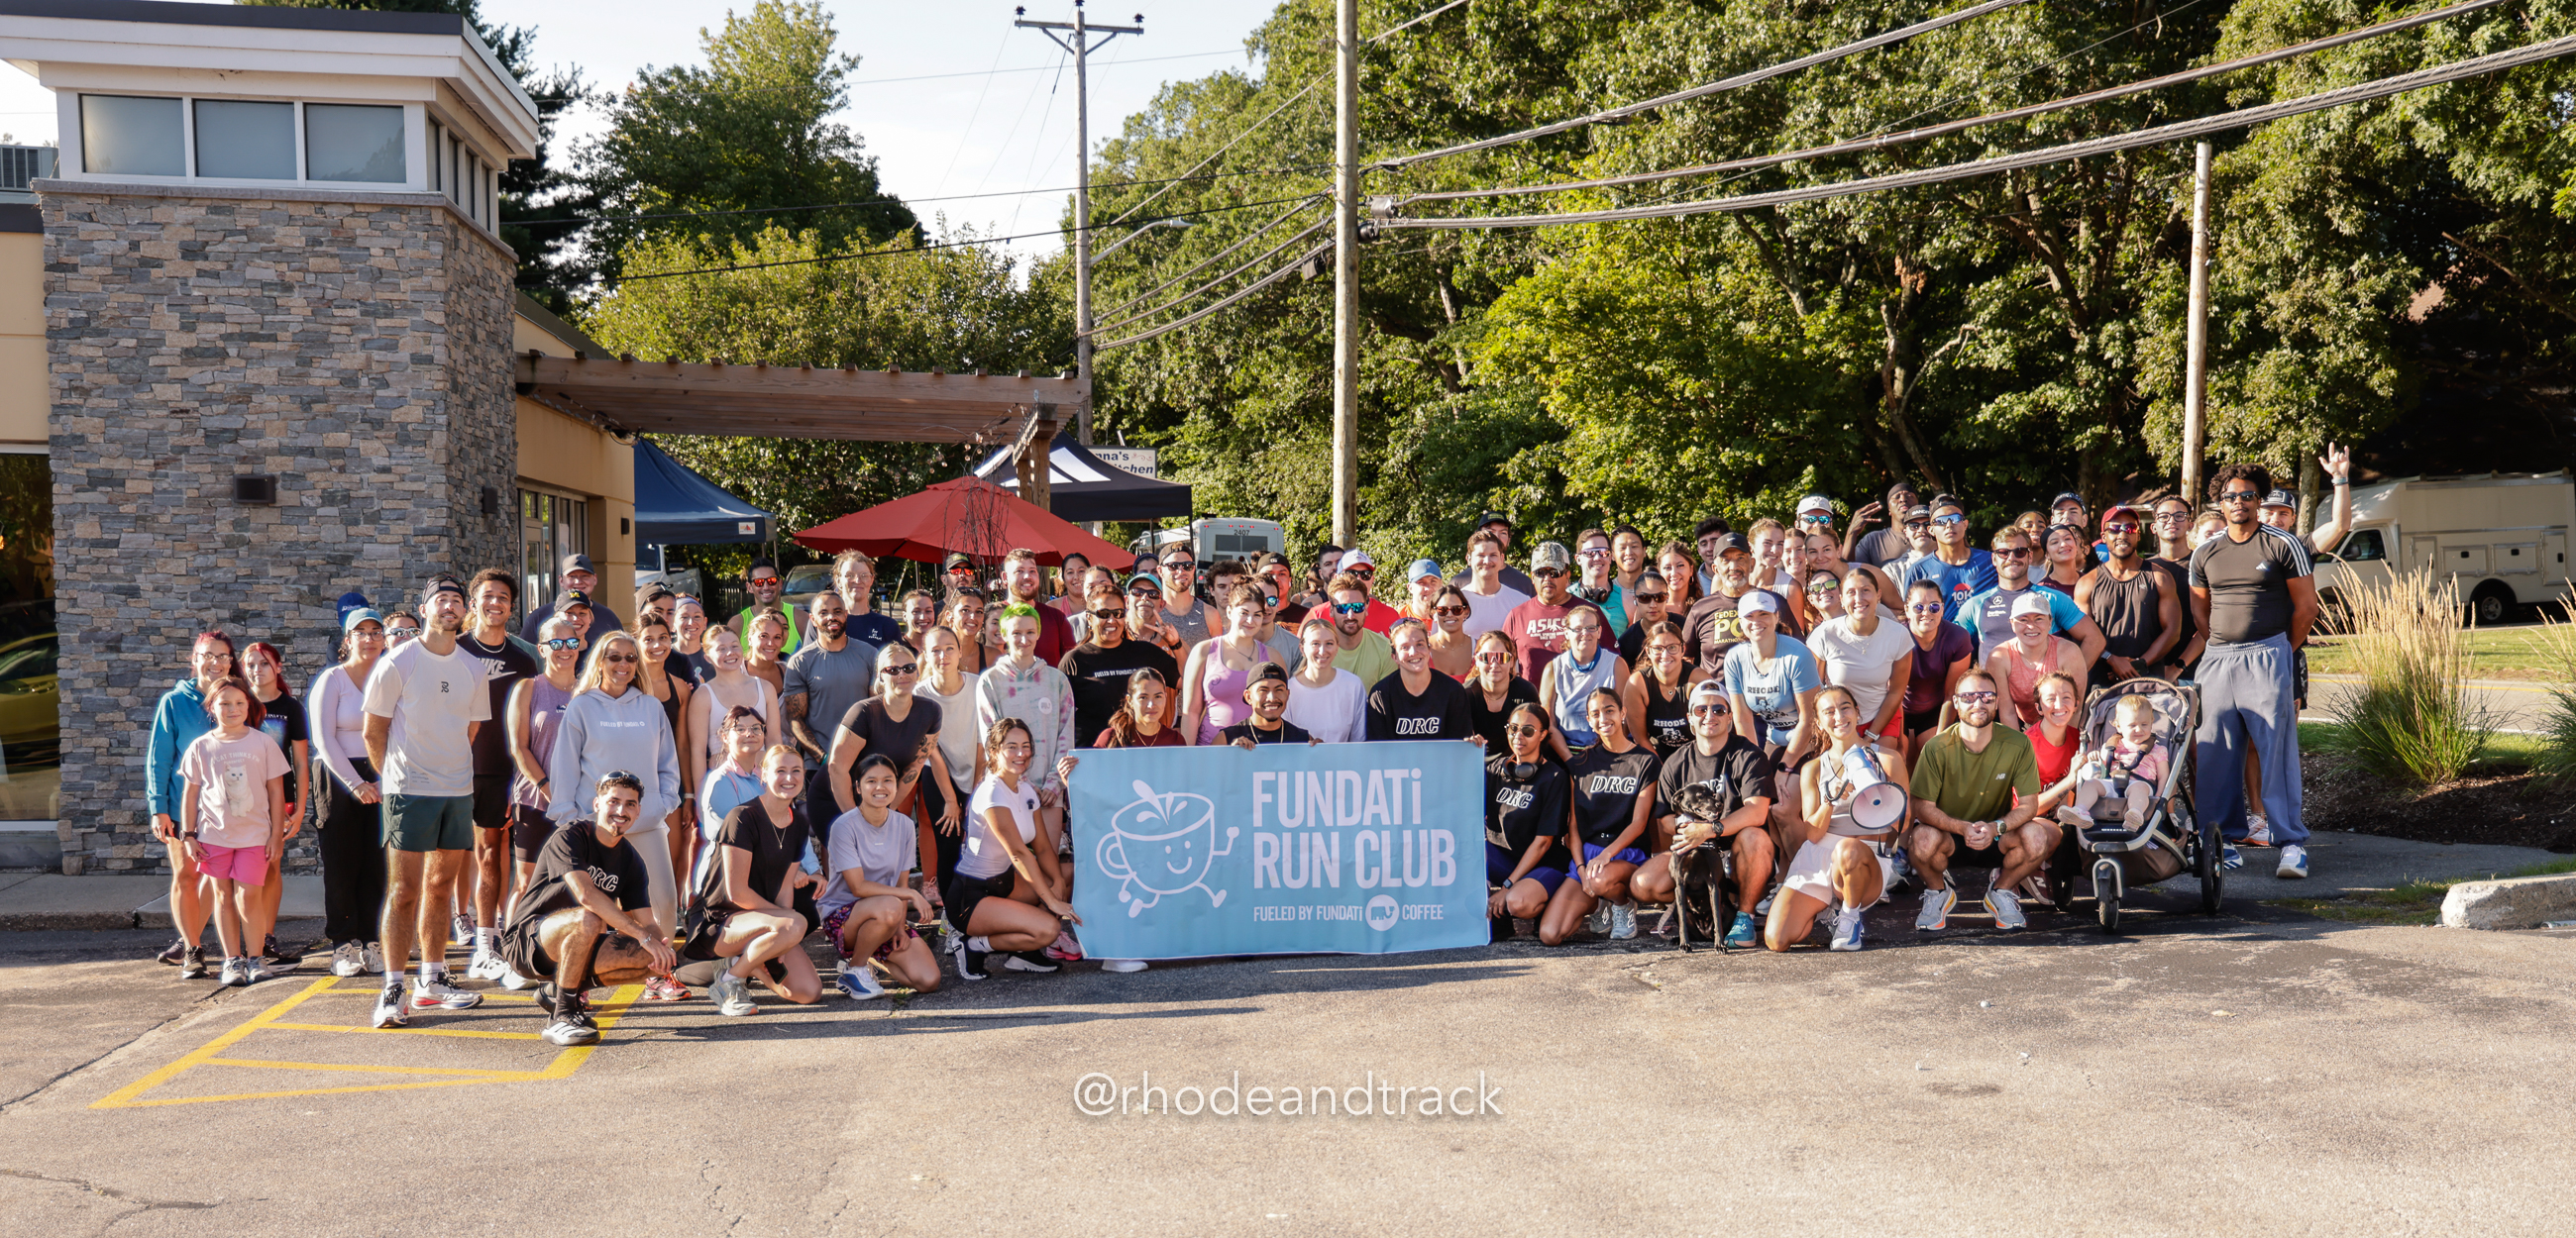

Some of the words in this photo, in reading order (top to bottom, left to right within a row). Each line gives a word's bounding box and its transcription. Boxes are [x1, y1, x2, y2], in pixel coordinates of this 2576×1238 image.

[1094, 670, 1110, 678] FUELED
[1747, 685, 1780, 694] RHODE
[1395, 716, 1440, 735] DRC
[1654, 718, 1686, 728] RHODE
[216, 754, 228, 763] CAT
[1590, 774, 1637, 794] DRC
[1252, 769, 1423, 829] FUNDATi
[1496, 786, 1534, 809] DRC
[1253, 831, 1341, 889] RUN
[1354, 829, 1456, 889] CLUB
[1253, 905, 1296, 922] FUELED
[1298, 905, 1314, 921] BY
[1401, 903, 1444, 921] COFFEE
